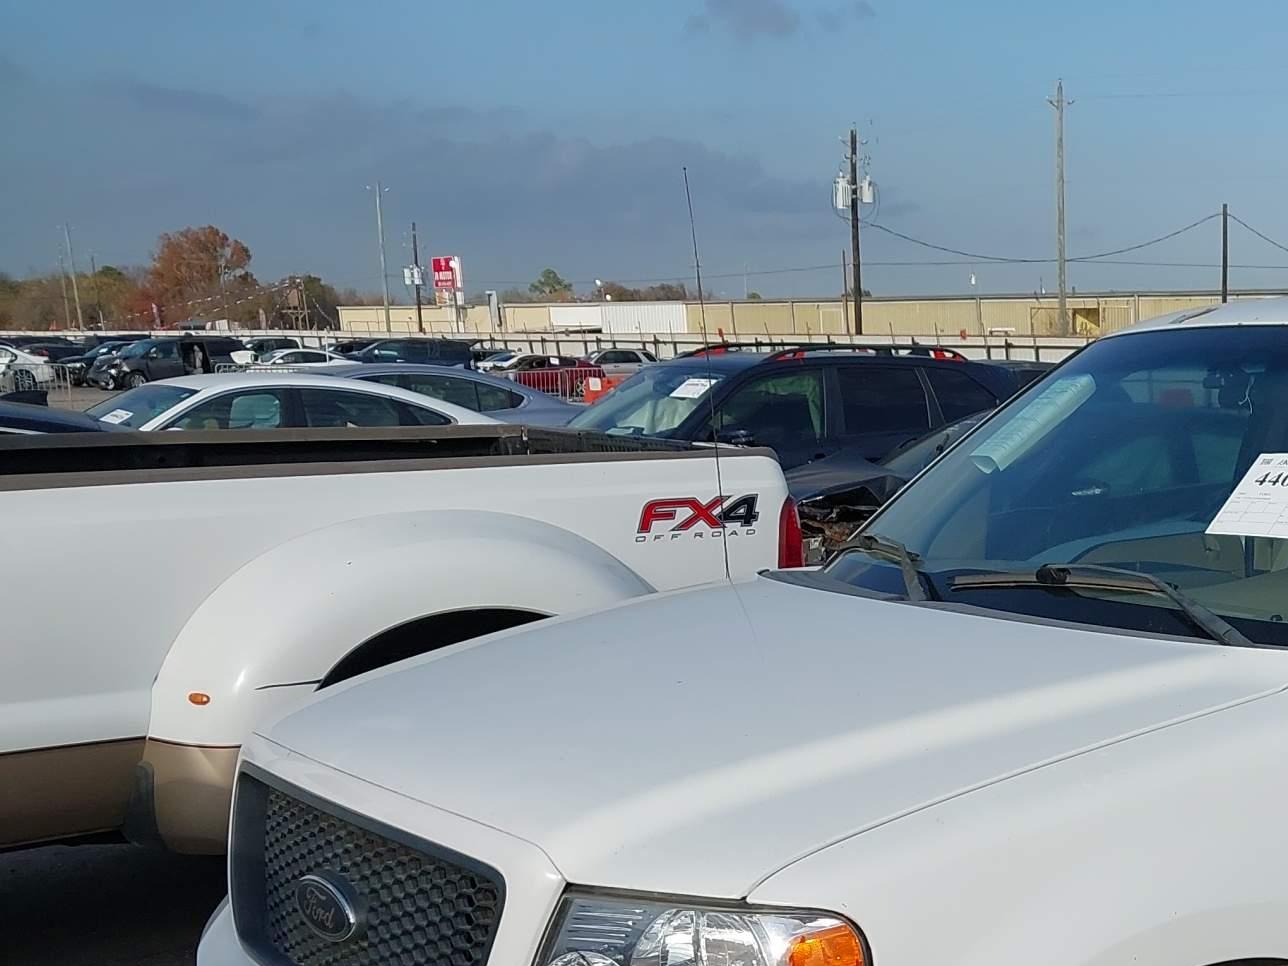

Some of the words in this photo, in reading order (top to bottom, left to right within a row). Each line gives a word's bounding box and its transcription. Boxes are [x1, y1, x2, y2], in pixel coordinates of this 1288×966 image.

[637, 493, 760, 534] FX4
[635, 533, 682, 543] OFF
[693, 528, 756, 539] ROAD
[304, 886, 336, 930] Ford
